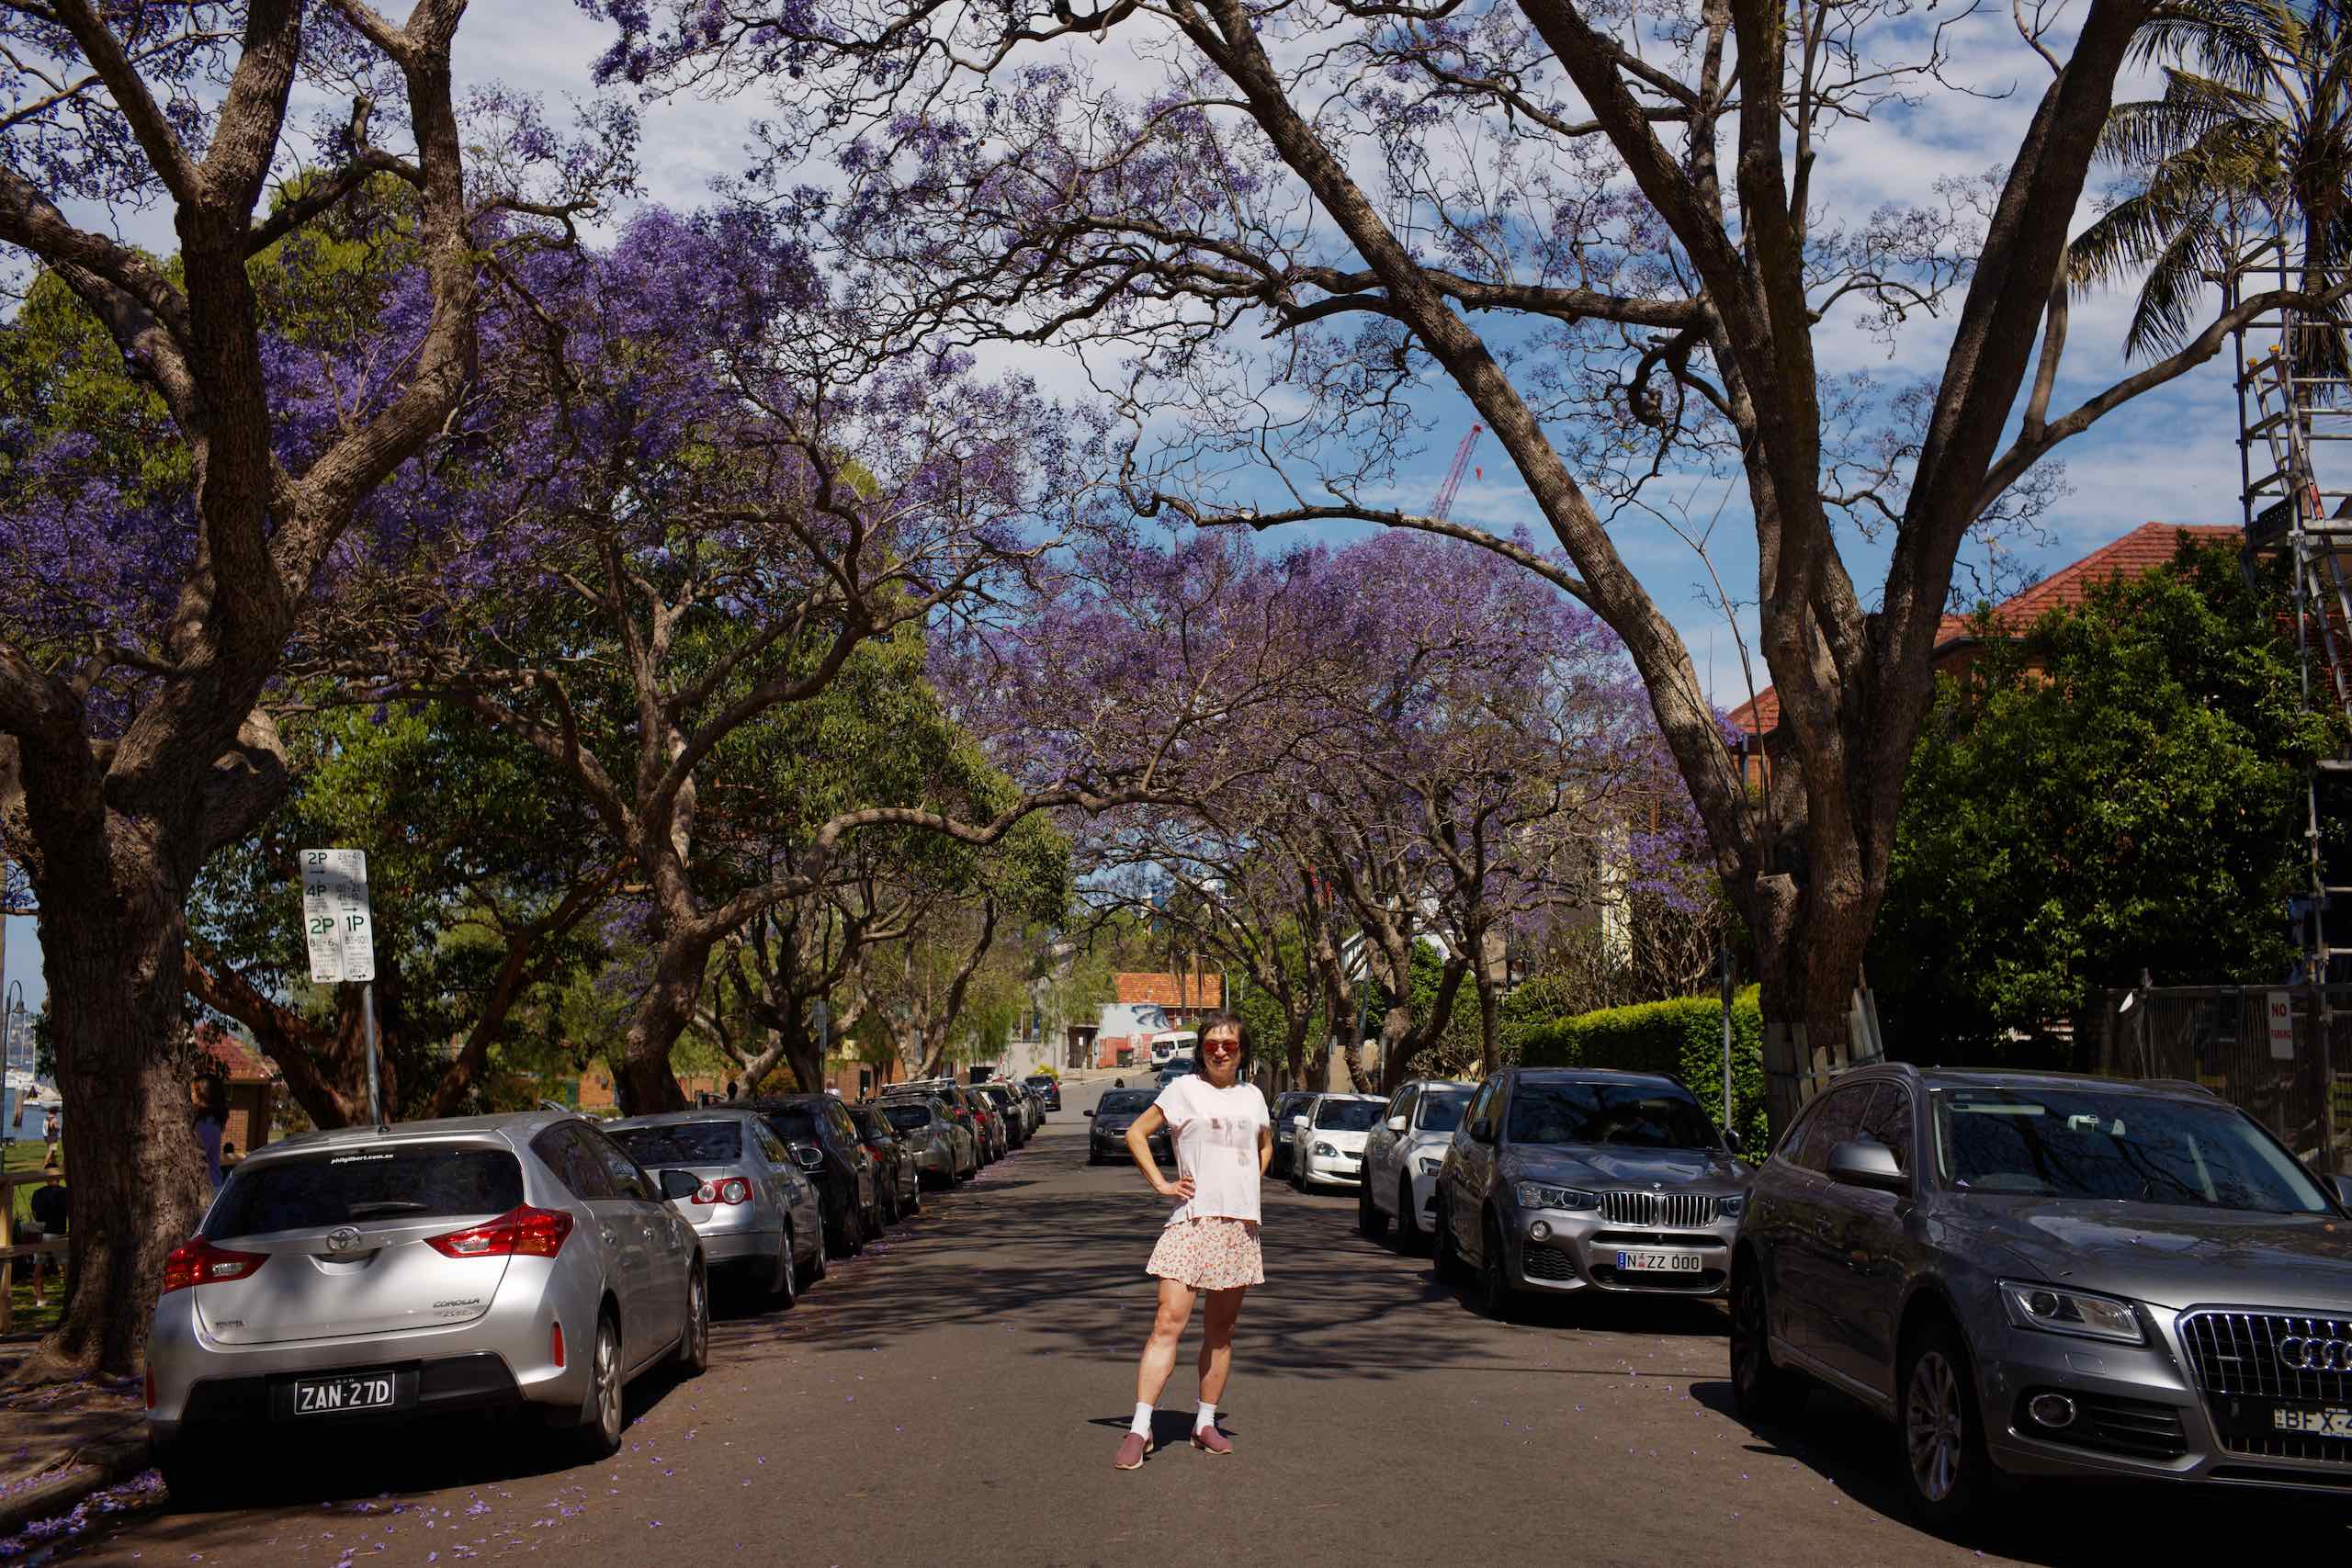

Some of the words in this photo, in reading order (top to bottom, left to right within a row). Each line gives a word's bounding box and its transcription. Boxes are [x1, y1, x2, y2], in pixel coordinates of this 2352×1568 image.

[308, 852, 327, 864] 2P
[306, 885, 326, 897] 4P
[310, 918, 334, 934] 2P
[346, 916, 364, 932] 1P
[2272, 1003, 2287, 1018] NO
[434, 1298, 480, 1308] COROLLA
